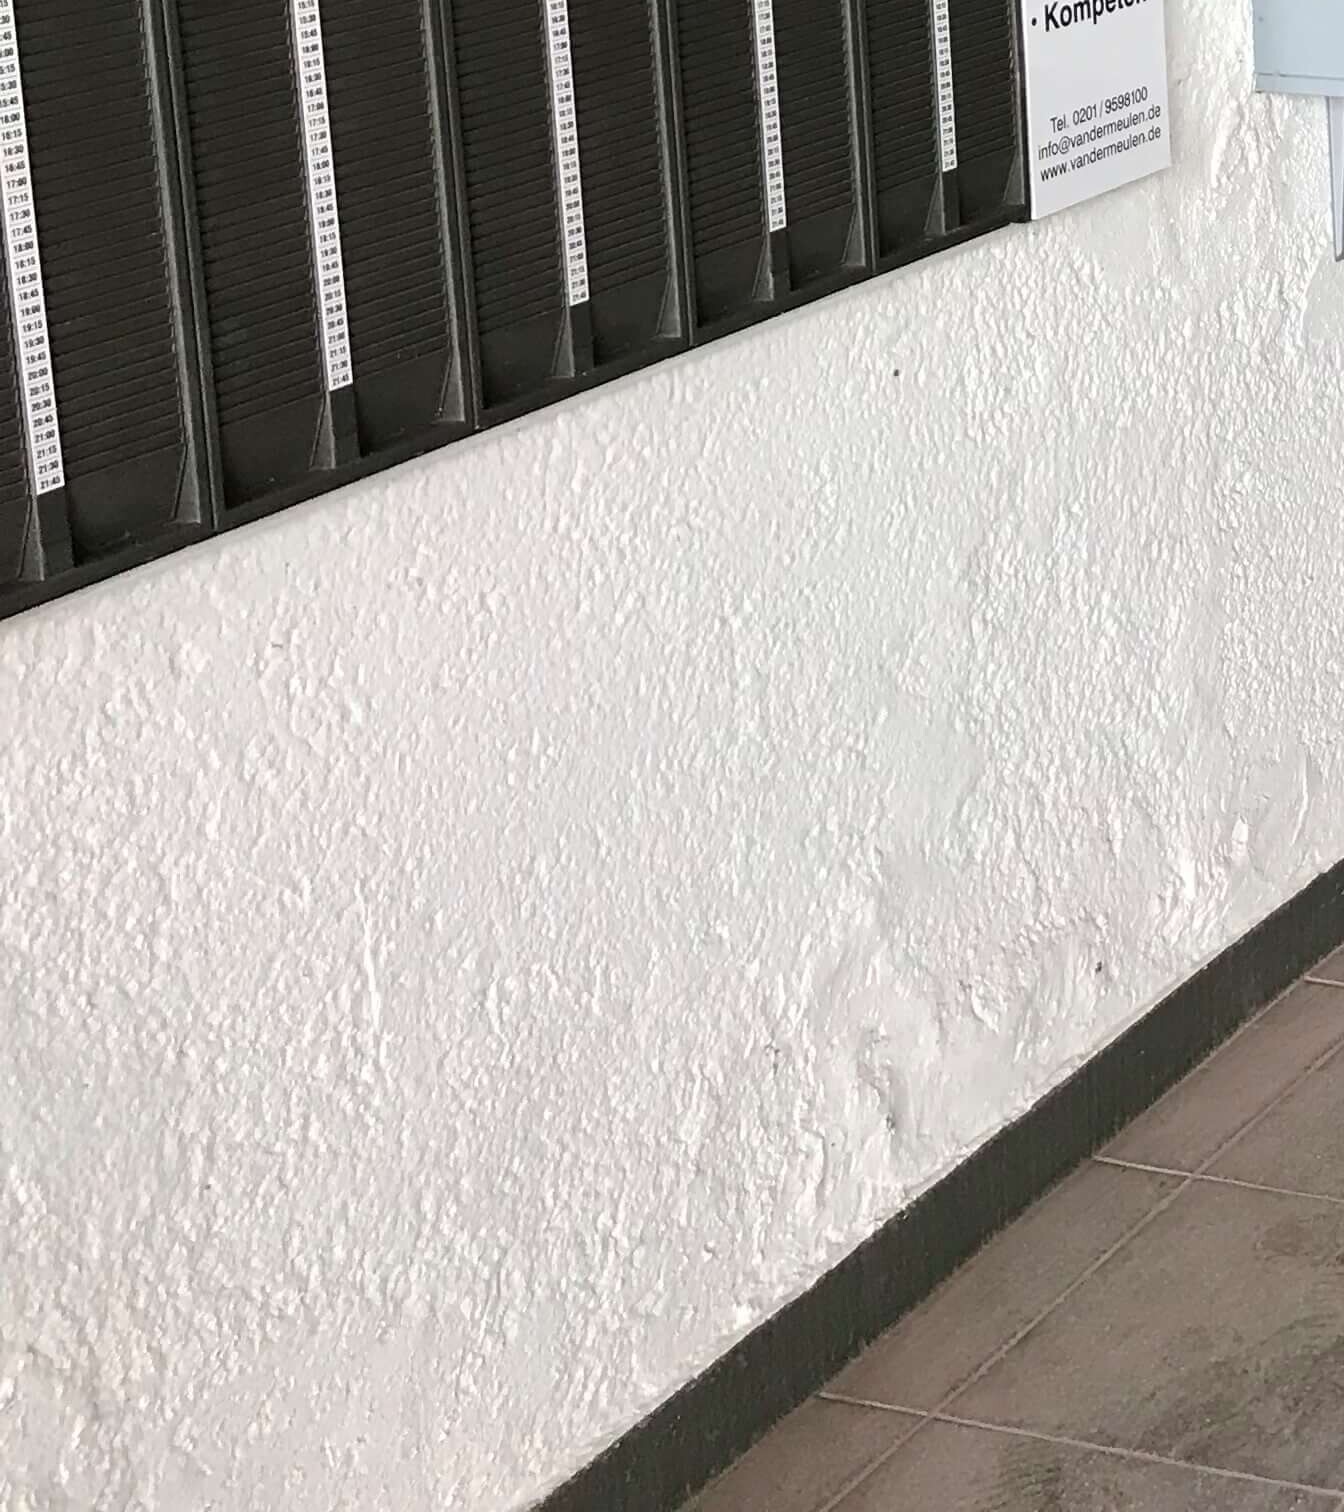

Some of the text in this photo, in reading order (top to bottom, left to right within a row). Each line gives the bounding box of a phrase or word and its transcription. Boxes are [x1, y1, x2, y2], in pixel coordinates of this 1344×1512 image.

[1038, 104, 1161, 161] info@vandermeulen.de
[1050, 114, 1069, 133] Tel.
[1072, 104, 1097, 125] 0201
[1104, 86, 1148, 114] 9598100
[1040, 126, 1161, 182] www.vandermeulen.de
